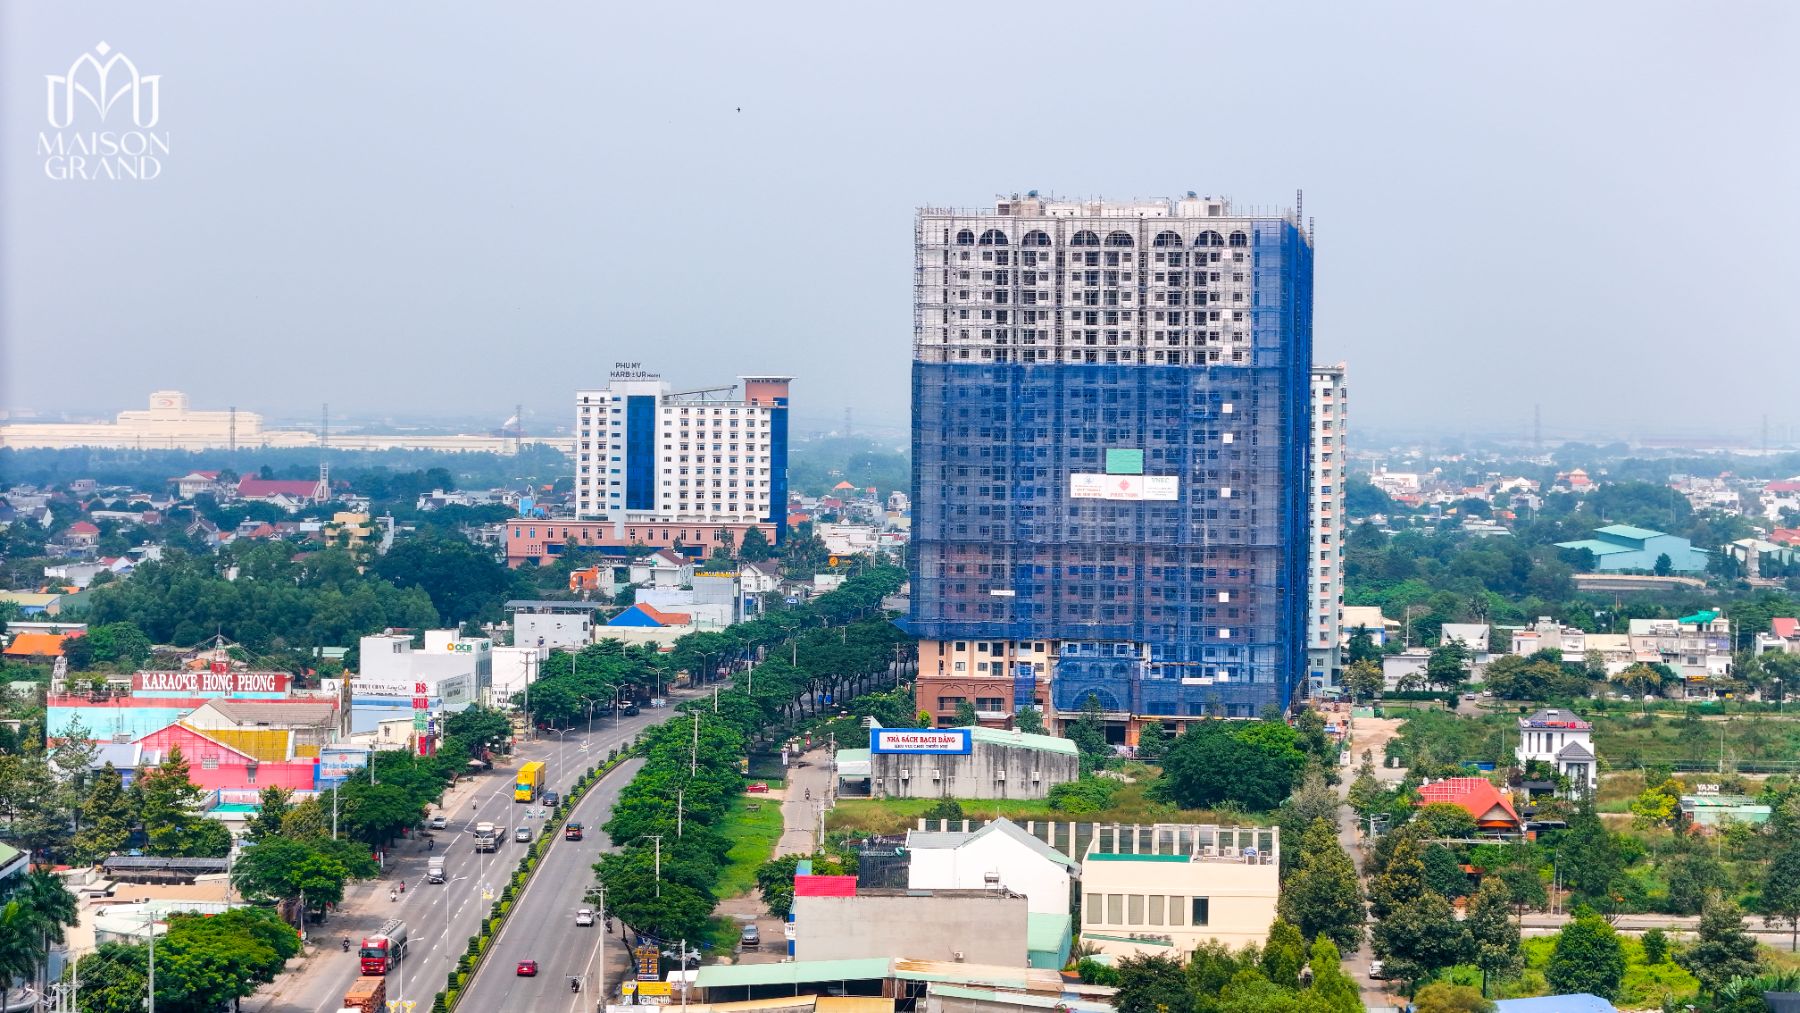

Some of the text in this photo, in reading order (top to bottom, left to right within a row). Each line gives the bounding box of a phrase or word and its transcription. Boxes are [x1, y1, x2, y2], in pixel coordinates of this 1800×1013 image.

[455, 643, 472, 651] OCB
[142, 673, 199, 690] KARAOKE
[237, 674, 276, 691] PHONG
